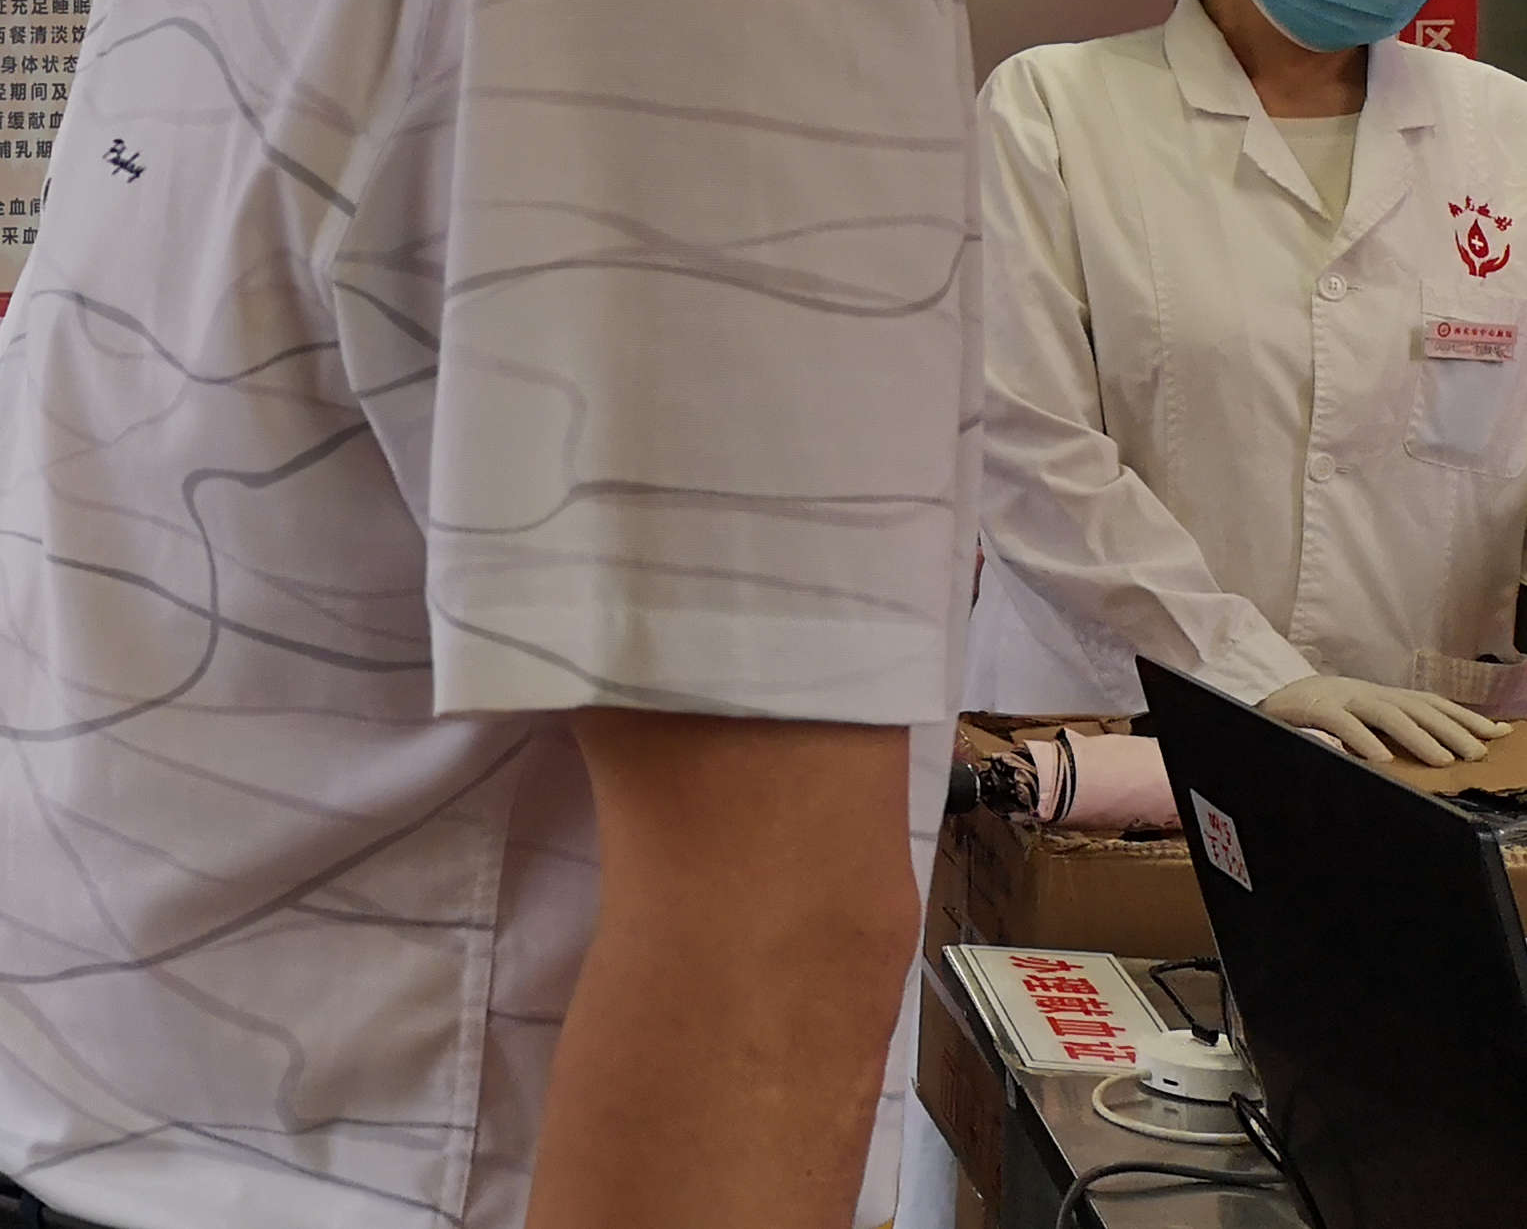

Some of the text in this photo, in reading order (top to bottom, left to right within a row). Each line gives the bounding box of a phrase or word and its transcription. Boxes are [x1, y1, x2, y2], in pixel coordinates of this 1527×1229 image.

[1009, 955, 1137, 1064] 办理献血证
